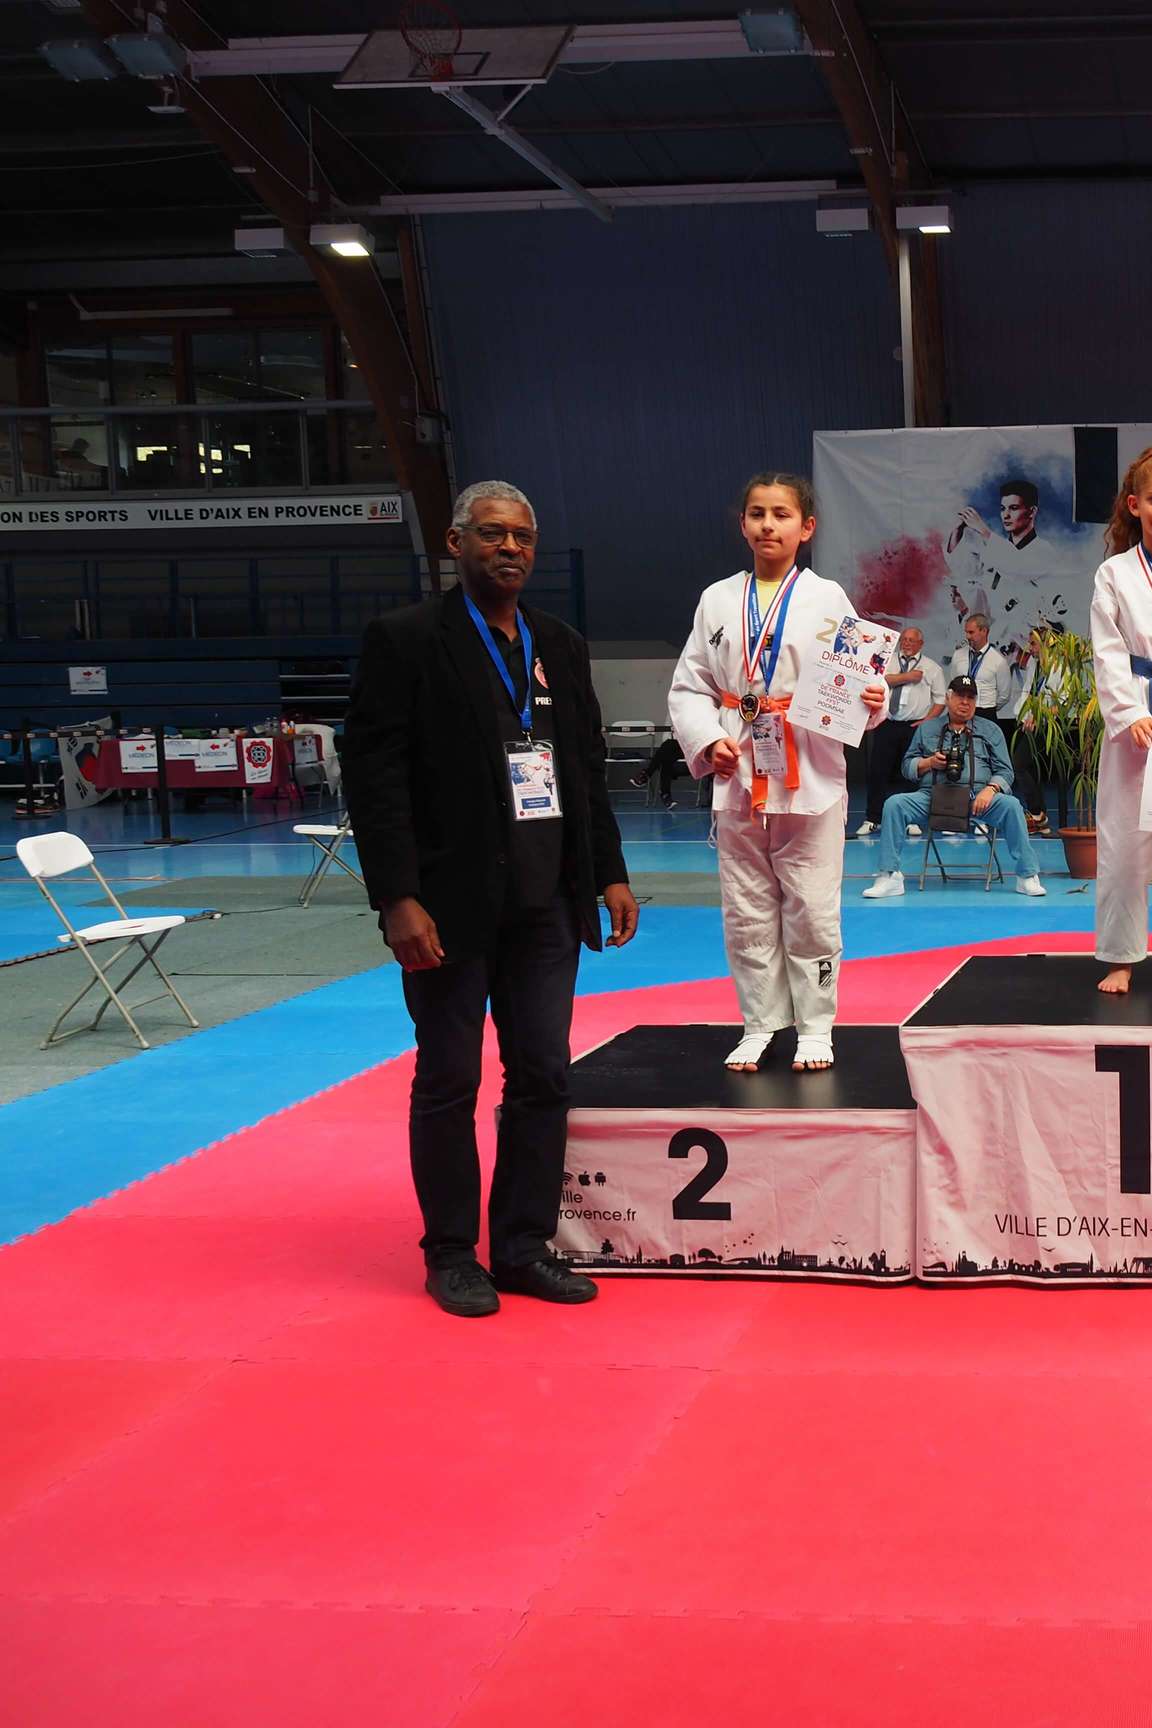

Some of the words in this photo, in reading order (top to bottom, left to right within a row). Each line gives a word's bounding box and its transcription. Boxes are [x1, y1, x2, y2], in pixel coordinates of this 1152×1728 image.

[147, 508, 194, 521] VILLE
[200, 507, 242, 520] D'AIX
[247, 506, 269, 519] EN
[275, 504, 363, 518] PROVENCE
[380, 501, 398, 514] AIX
[29, 511, 60, 523] DES
[65, 510, 129, 522] SPORTS
[815, 618, 838, 644] 2
[822, 650, 870, 675] DIPLÔME
[534, 696, 552, 706] PRE
[1095, 1045, 1152, 1194] 1
[667, 1127, 733, 1221] 2
[561, 1189, 584, 1204] ille
[559, 1207, 637, 1222] rovence.fr
[994, 1213, 1048, 1239] VILLE
